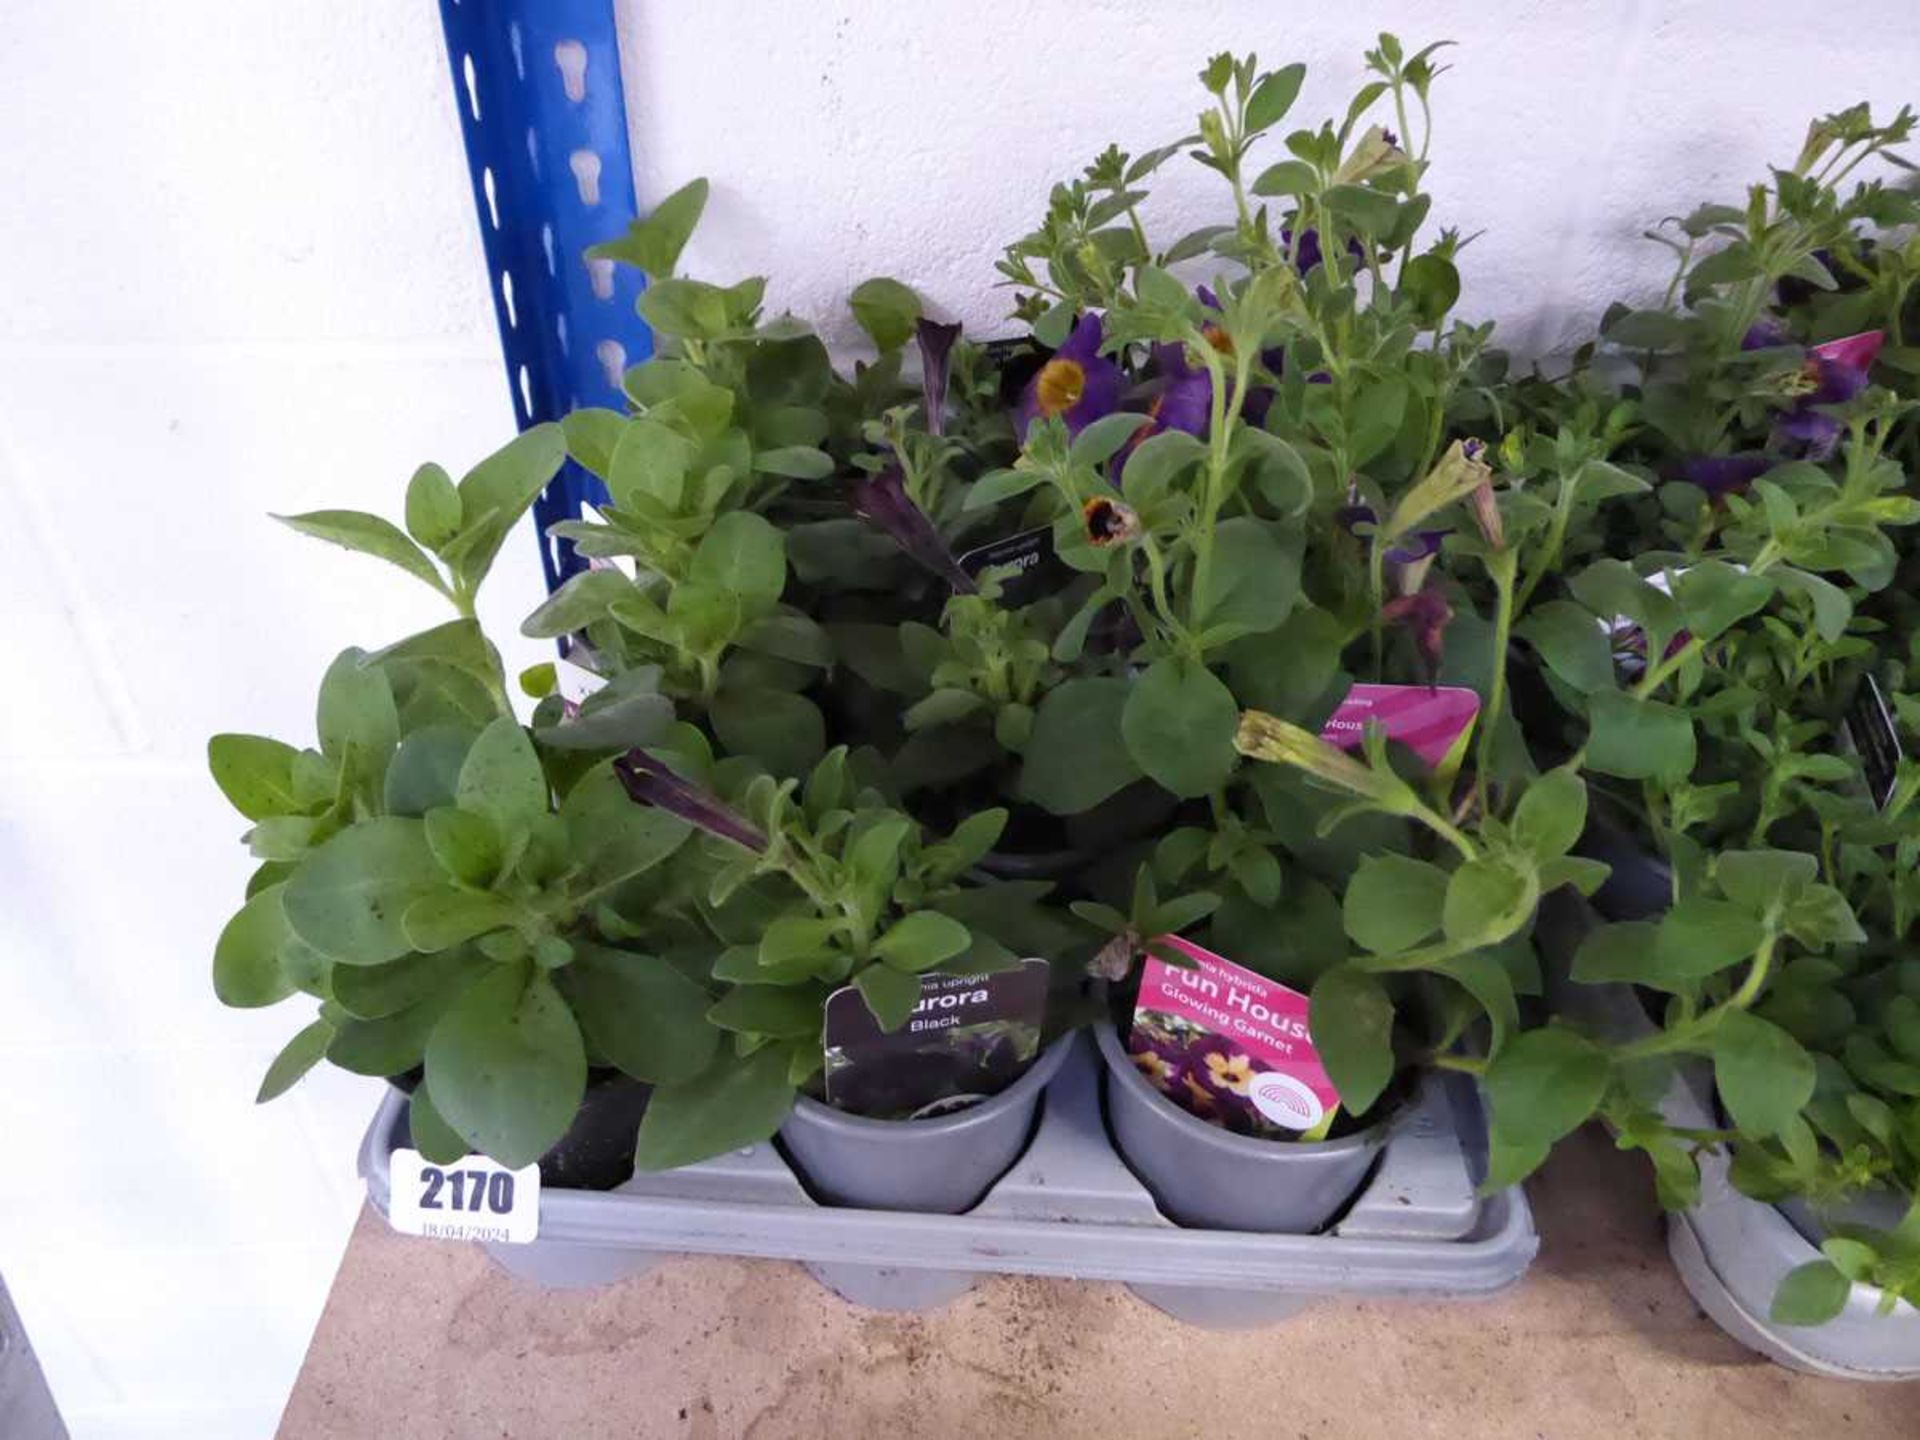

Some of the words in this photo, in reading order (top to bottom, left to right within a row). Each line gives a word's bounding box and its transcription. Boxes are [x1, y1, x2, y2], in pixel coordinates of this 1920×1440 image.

[1164, 964, 1219, 998] Fun
[911, 989, 989, 1013] urora
[910, 1015, 961, 1032] Black
[1161, 982, 1230, 1026] Glowing
[1233, 1018, 1294, 1056] Garnet
[419, 1167, 515, 1215] 2170
